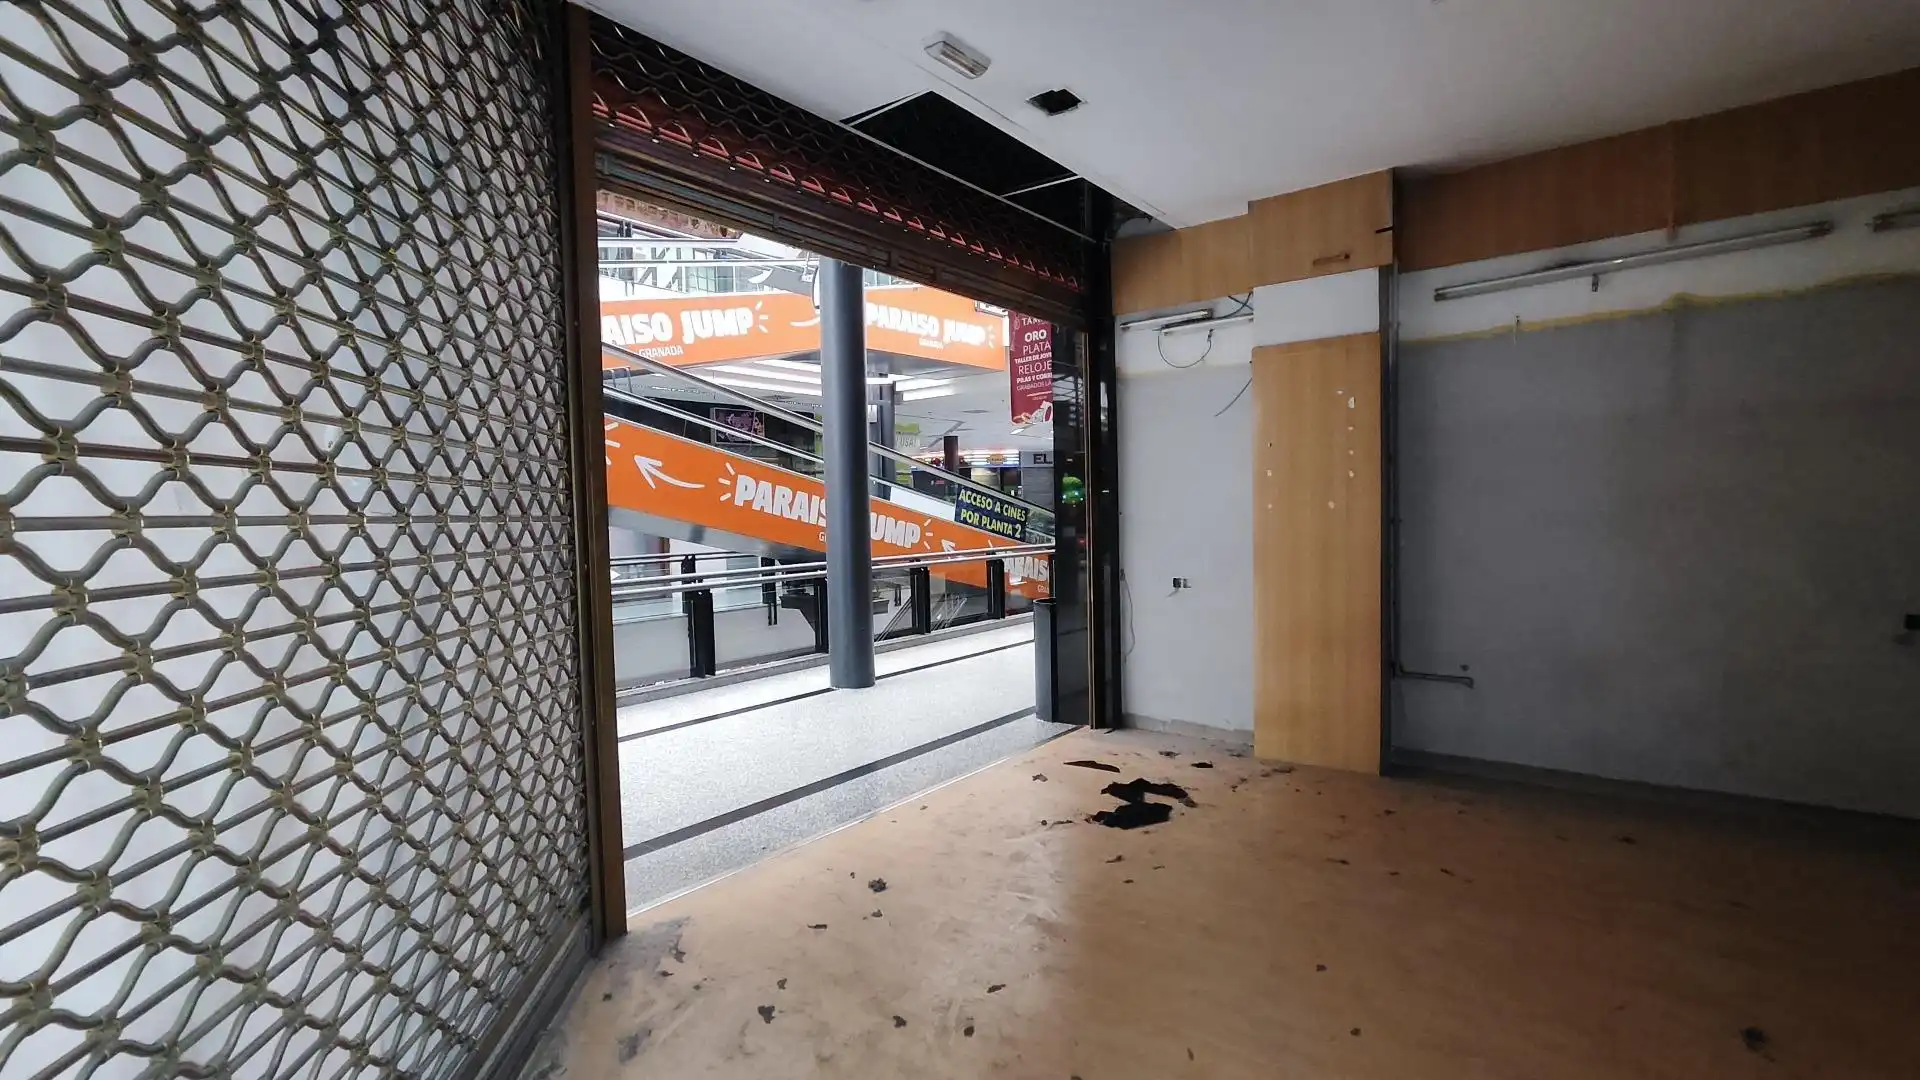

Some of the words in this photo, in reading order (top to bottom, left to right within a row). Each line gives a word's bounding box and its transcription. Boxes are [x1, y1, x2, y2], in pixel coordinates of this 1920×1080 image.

[602, 312, 673, 345] AISO
[680, 306, 754, 344] JUMP
[865, 302, 940, 338] PARAISO
[638, 344, 684, 358] GRANADA
[1023, 341, 1052, 356] PLATA
[1024, 329, 1047, 343] ORO
[734, 474, 827, 528] PARAIS
[870, 512, 921, 549] UMP
[958, 488, 993, 510] ACCESO
[994, 501, 1001, 514] A
[1002, 504, 1026, 522] CINES
[960, 508, 980, 526] POR
[981, 515, 1013, 536] PLANTA
[1014, 523, 1022, 539] 2
[998, 551, 1049, 581] ARAIS
